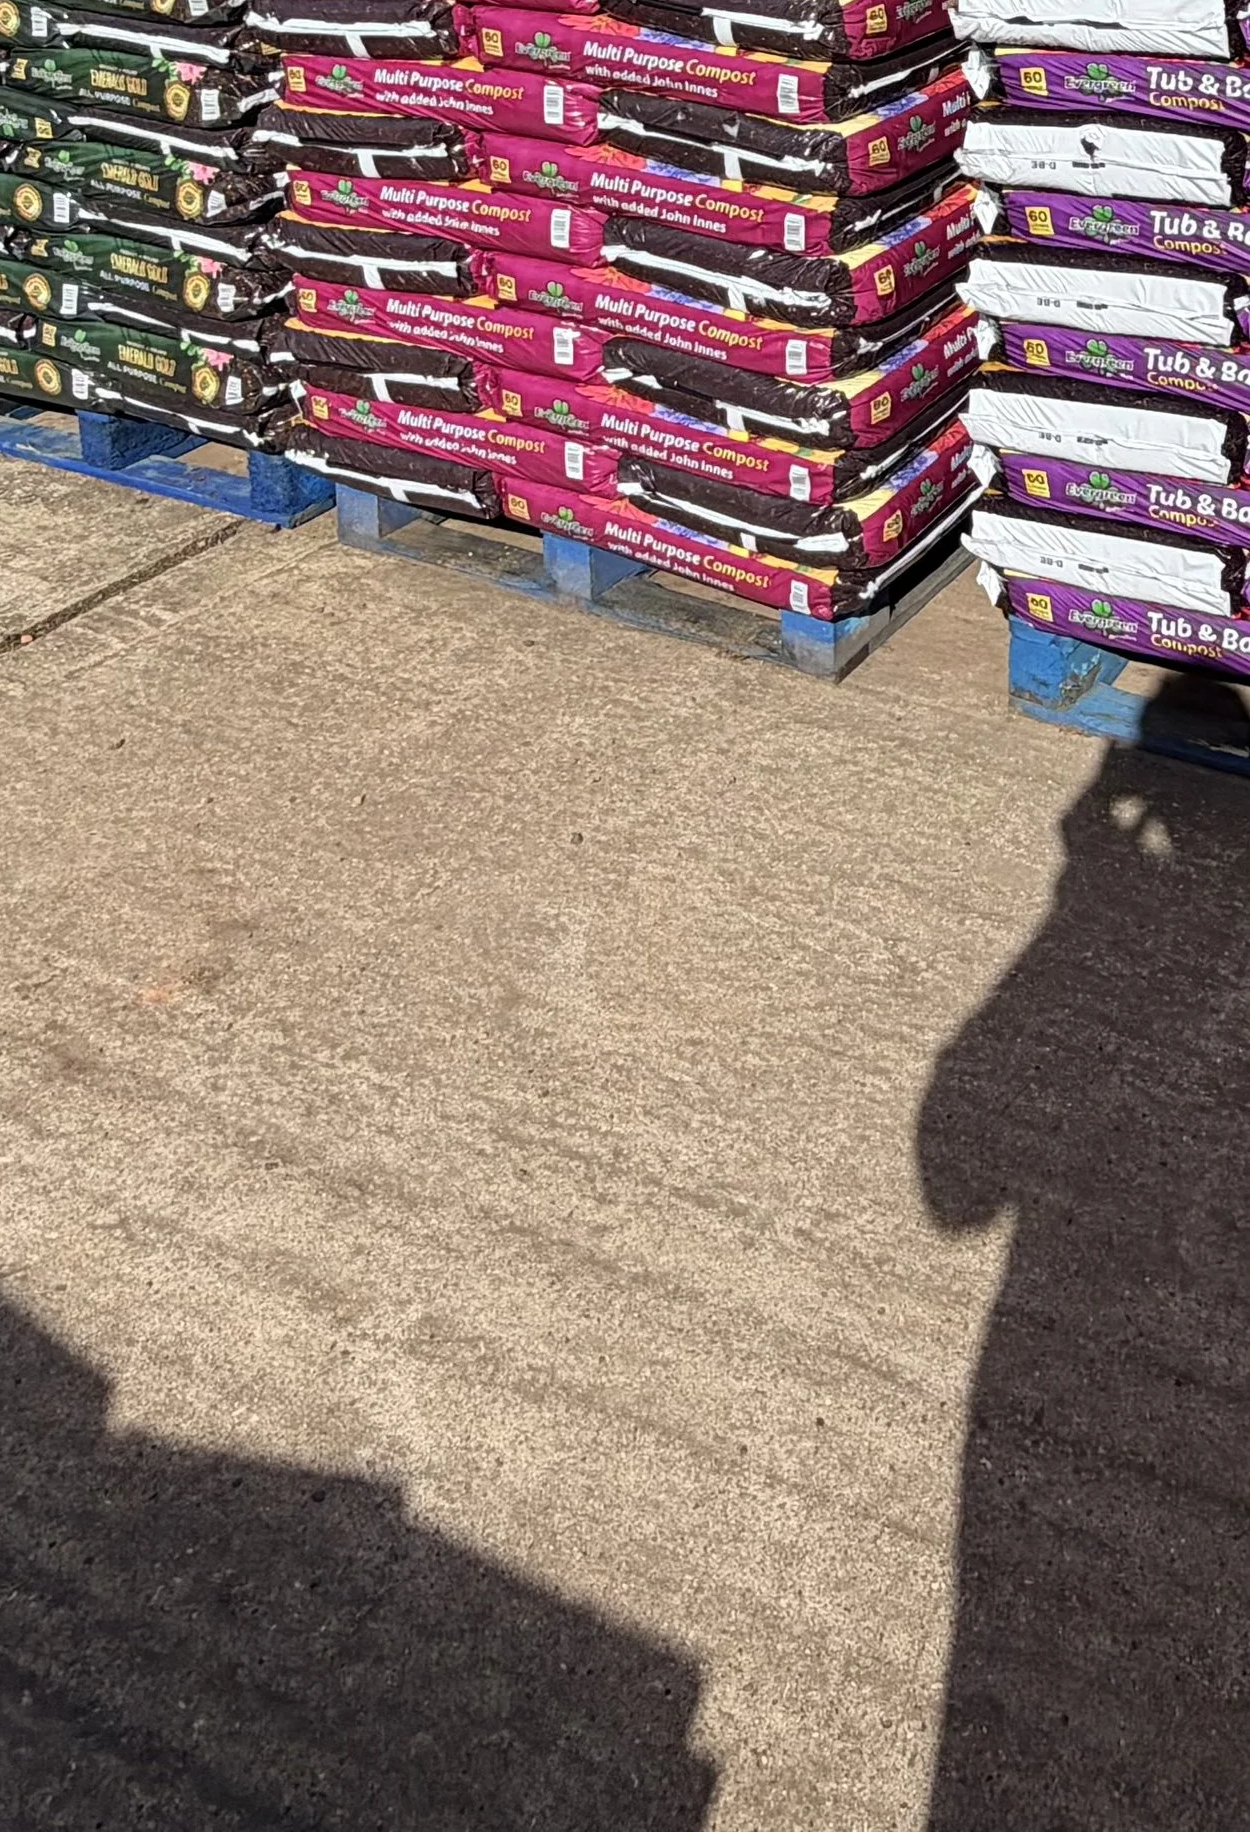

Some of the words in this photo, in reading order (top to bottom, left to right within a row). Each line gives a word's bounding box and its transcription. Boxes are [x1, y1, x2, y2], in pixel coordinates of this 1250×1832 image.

[583, 41, 622, 62] Multi
[622, 46, 685, 73] Purpose
[686, 58, 757, 86] Compost
[1147, 67, 1193, 91] Tub
[1199, 74, 1219, 96] &
[590, 172, 630, 193] Multi
[631, 178, 695, 207] Purpose
[695, 193, 766, 223] Compost
[1029, 211, 1047, 222] 60
[1150, 211, 1197, 236] Tub
[1202, 214, 1221, 239] &
[397, 410, 432, 429] Multi
[432, 417, 487, 443] Purpose
[487, 429, 546, 455] Compost
[601, 413, 639, 435] Multi
[640, 424, 700, 452] Purpose
[702, 441, 770, 472] Compost
[1148, 612, 1192, 636] Tub
[1198, 623, 1217, 641] &
